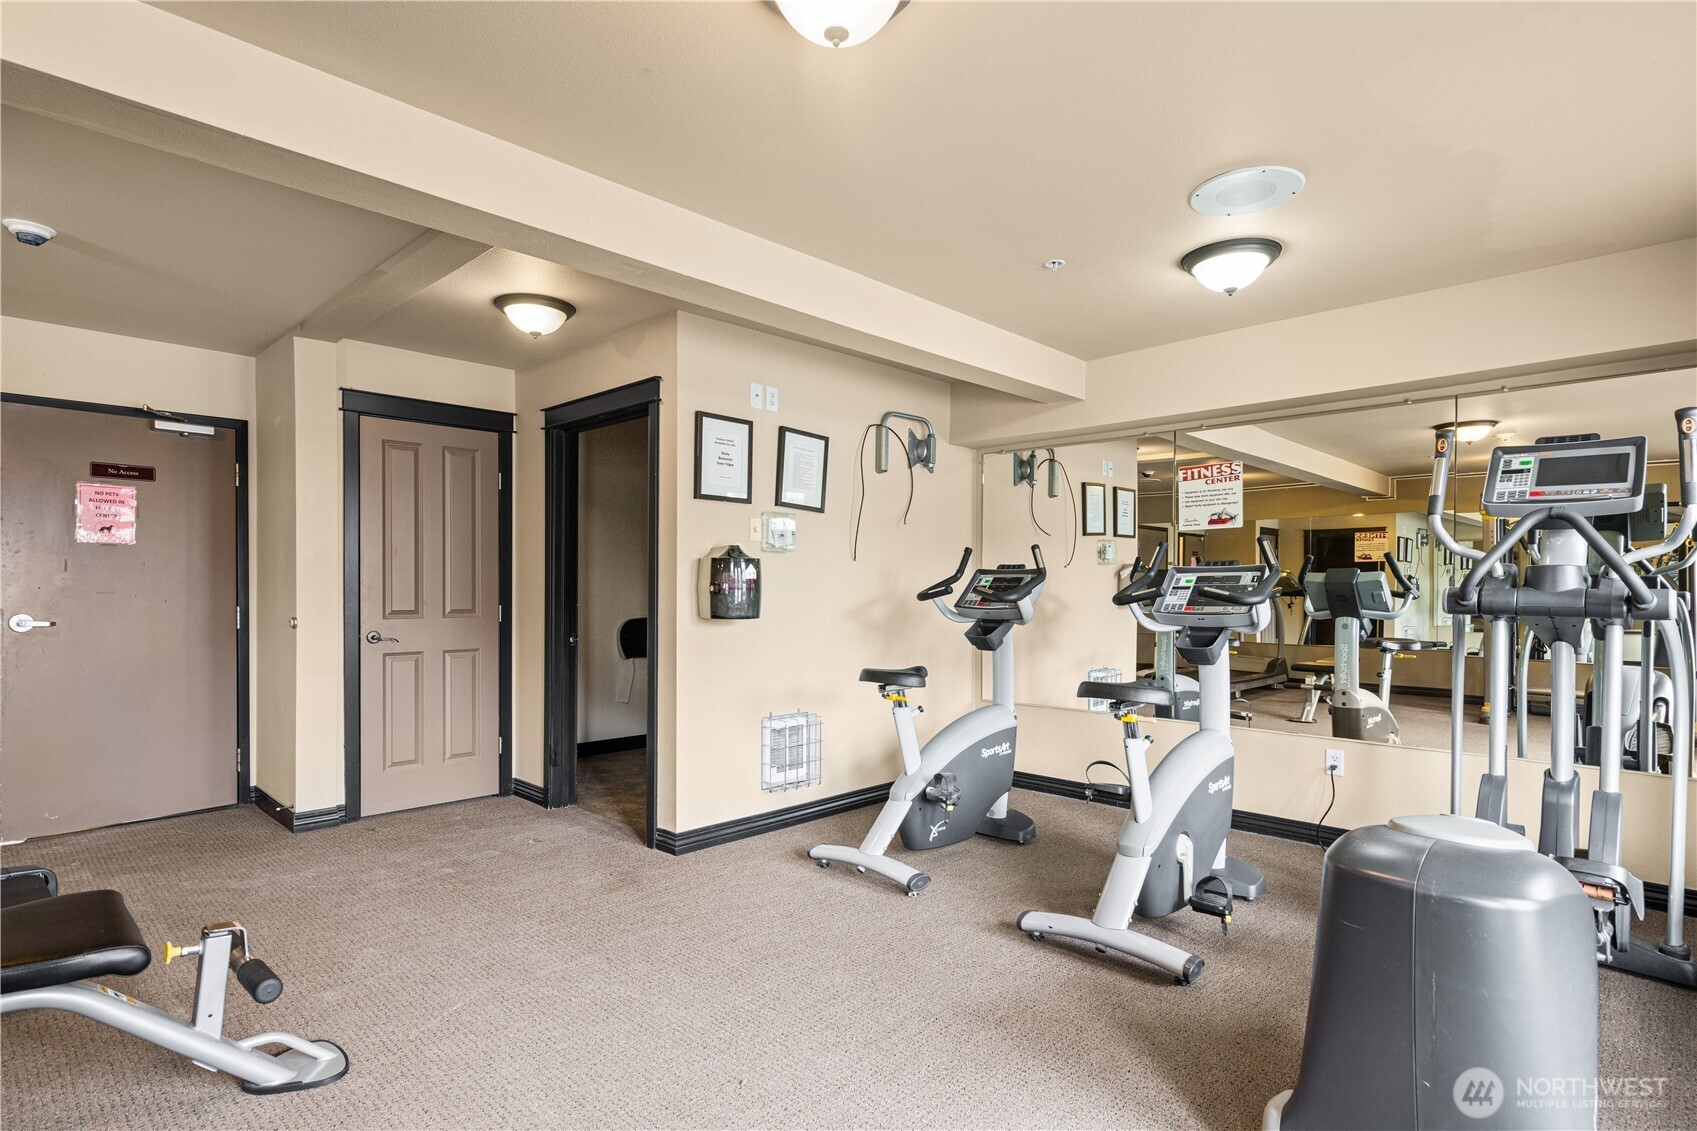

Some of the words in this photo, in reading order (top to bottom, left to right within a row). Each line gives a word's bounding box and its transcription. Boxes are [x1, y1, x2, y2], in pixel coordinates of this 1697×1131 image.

[1179, 462, 1241, 481] FITNESS
[1205, 475, 1240, 485] CENTER
[981, 742, 1010, 758] SportsArt
[1208, 775, 1231, 795] SportsArt
